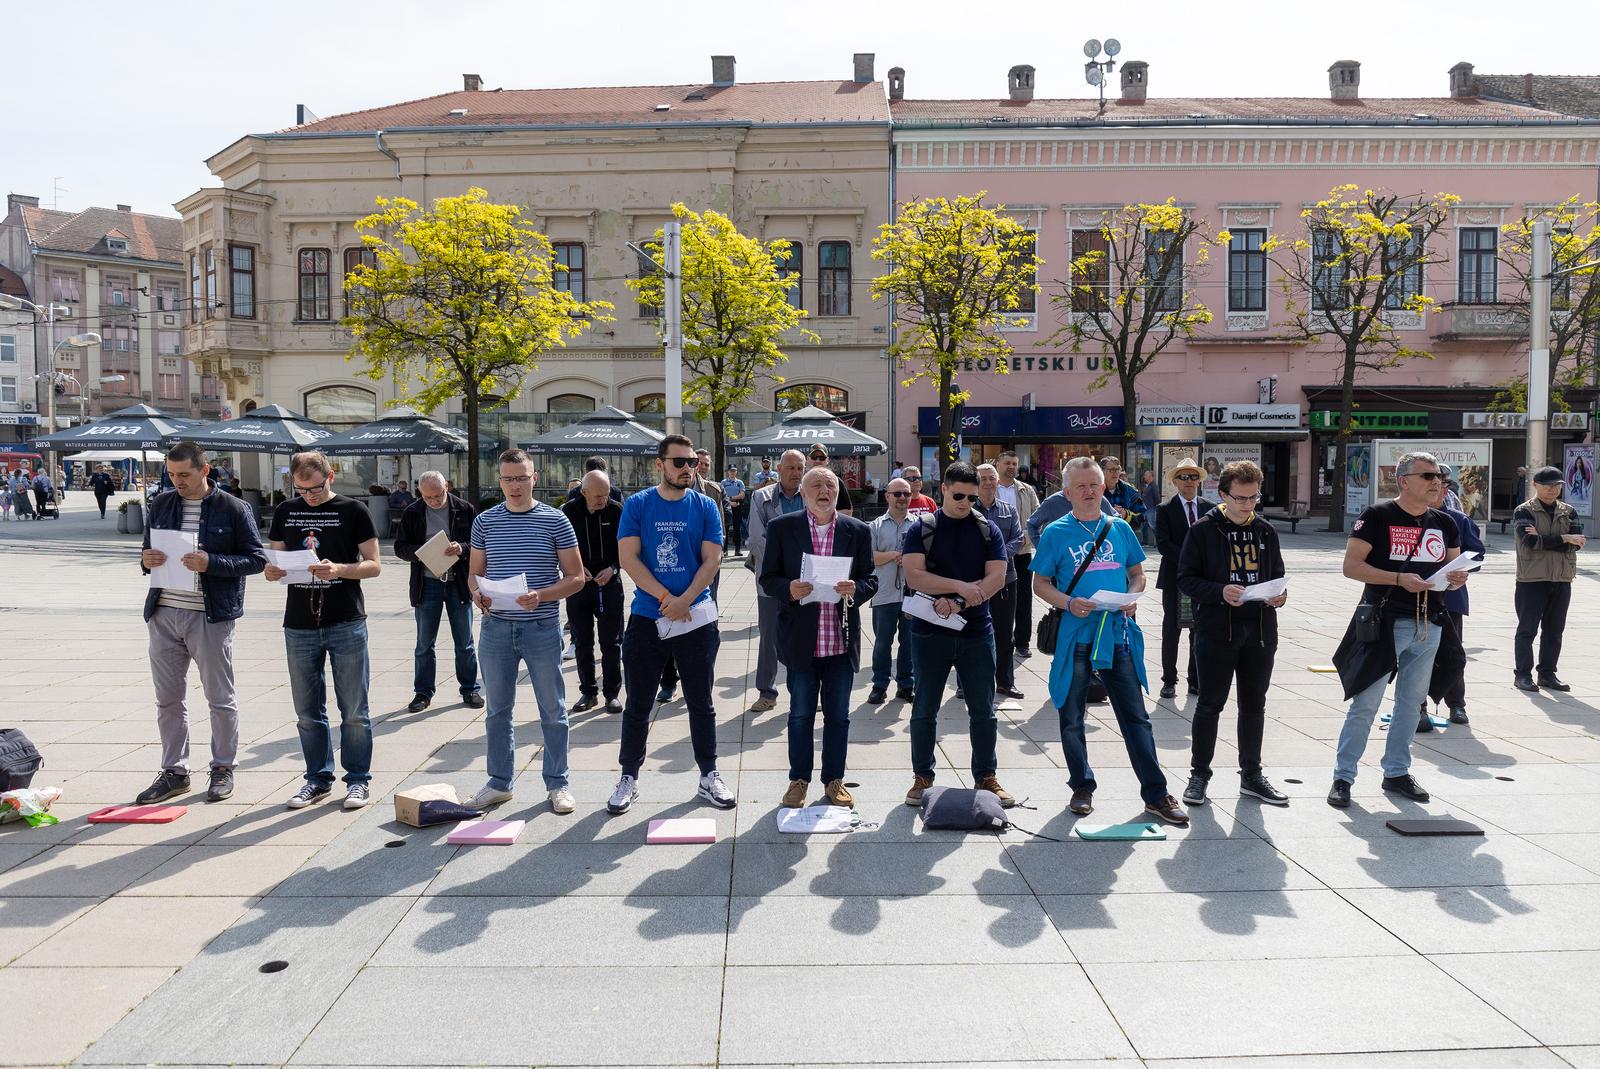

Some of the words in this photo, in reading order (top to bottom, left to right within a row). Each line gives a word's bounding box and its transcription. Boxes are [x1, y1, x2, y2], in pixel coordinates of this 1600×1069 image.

[953, 357, 1073, 371] EODETSKI
[1232, 412, 1258, 422] Danijel
[1259, 412, 1297, 420] Cosmetics
[1467, 414, 1584, 428] LJEKNA
[210, 427, 274, 436] Jamnica
[350, 431, 416, 440] Jamnica
[564, 431, 631, 439] Jamnica
